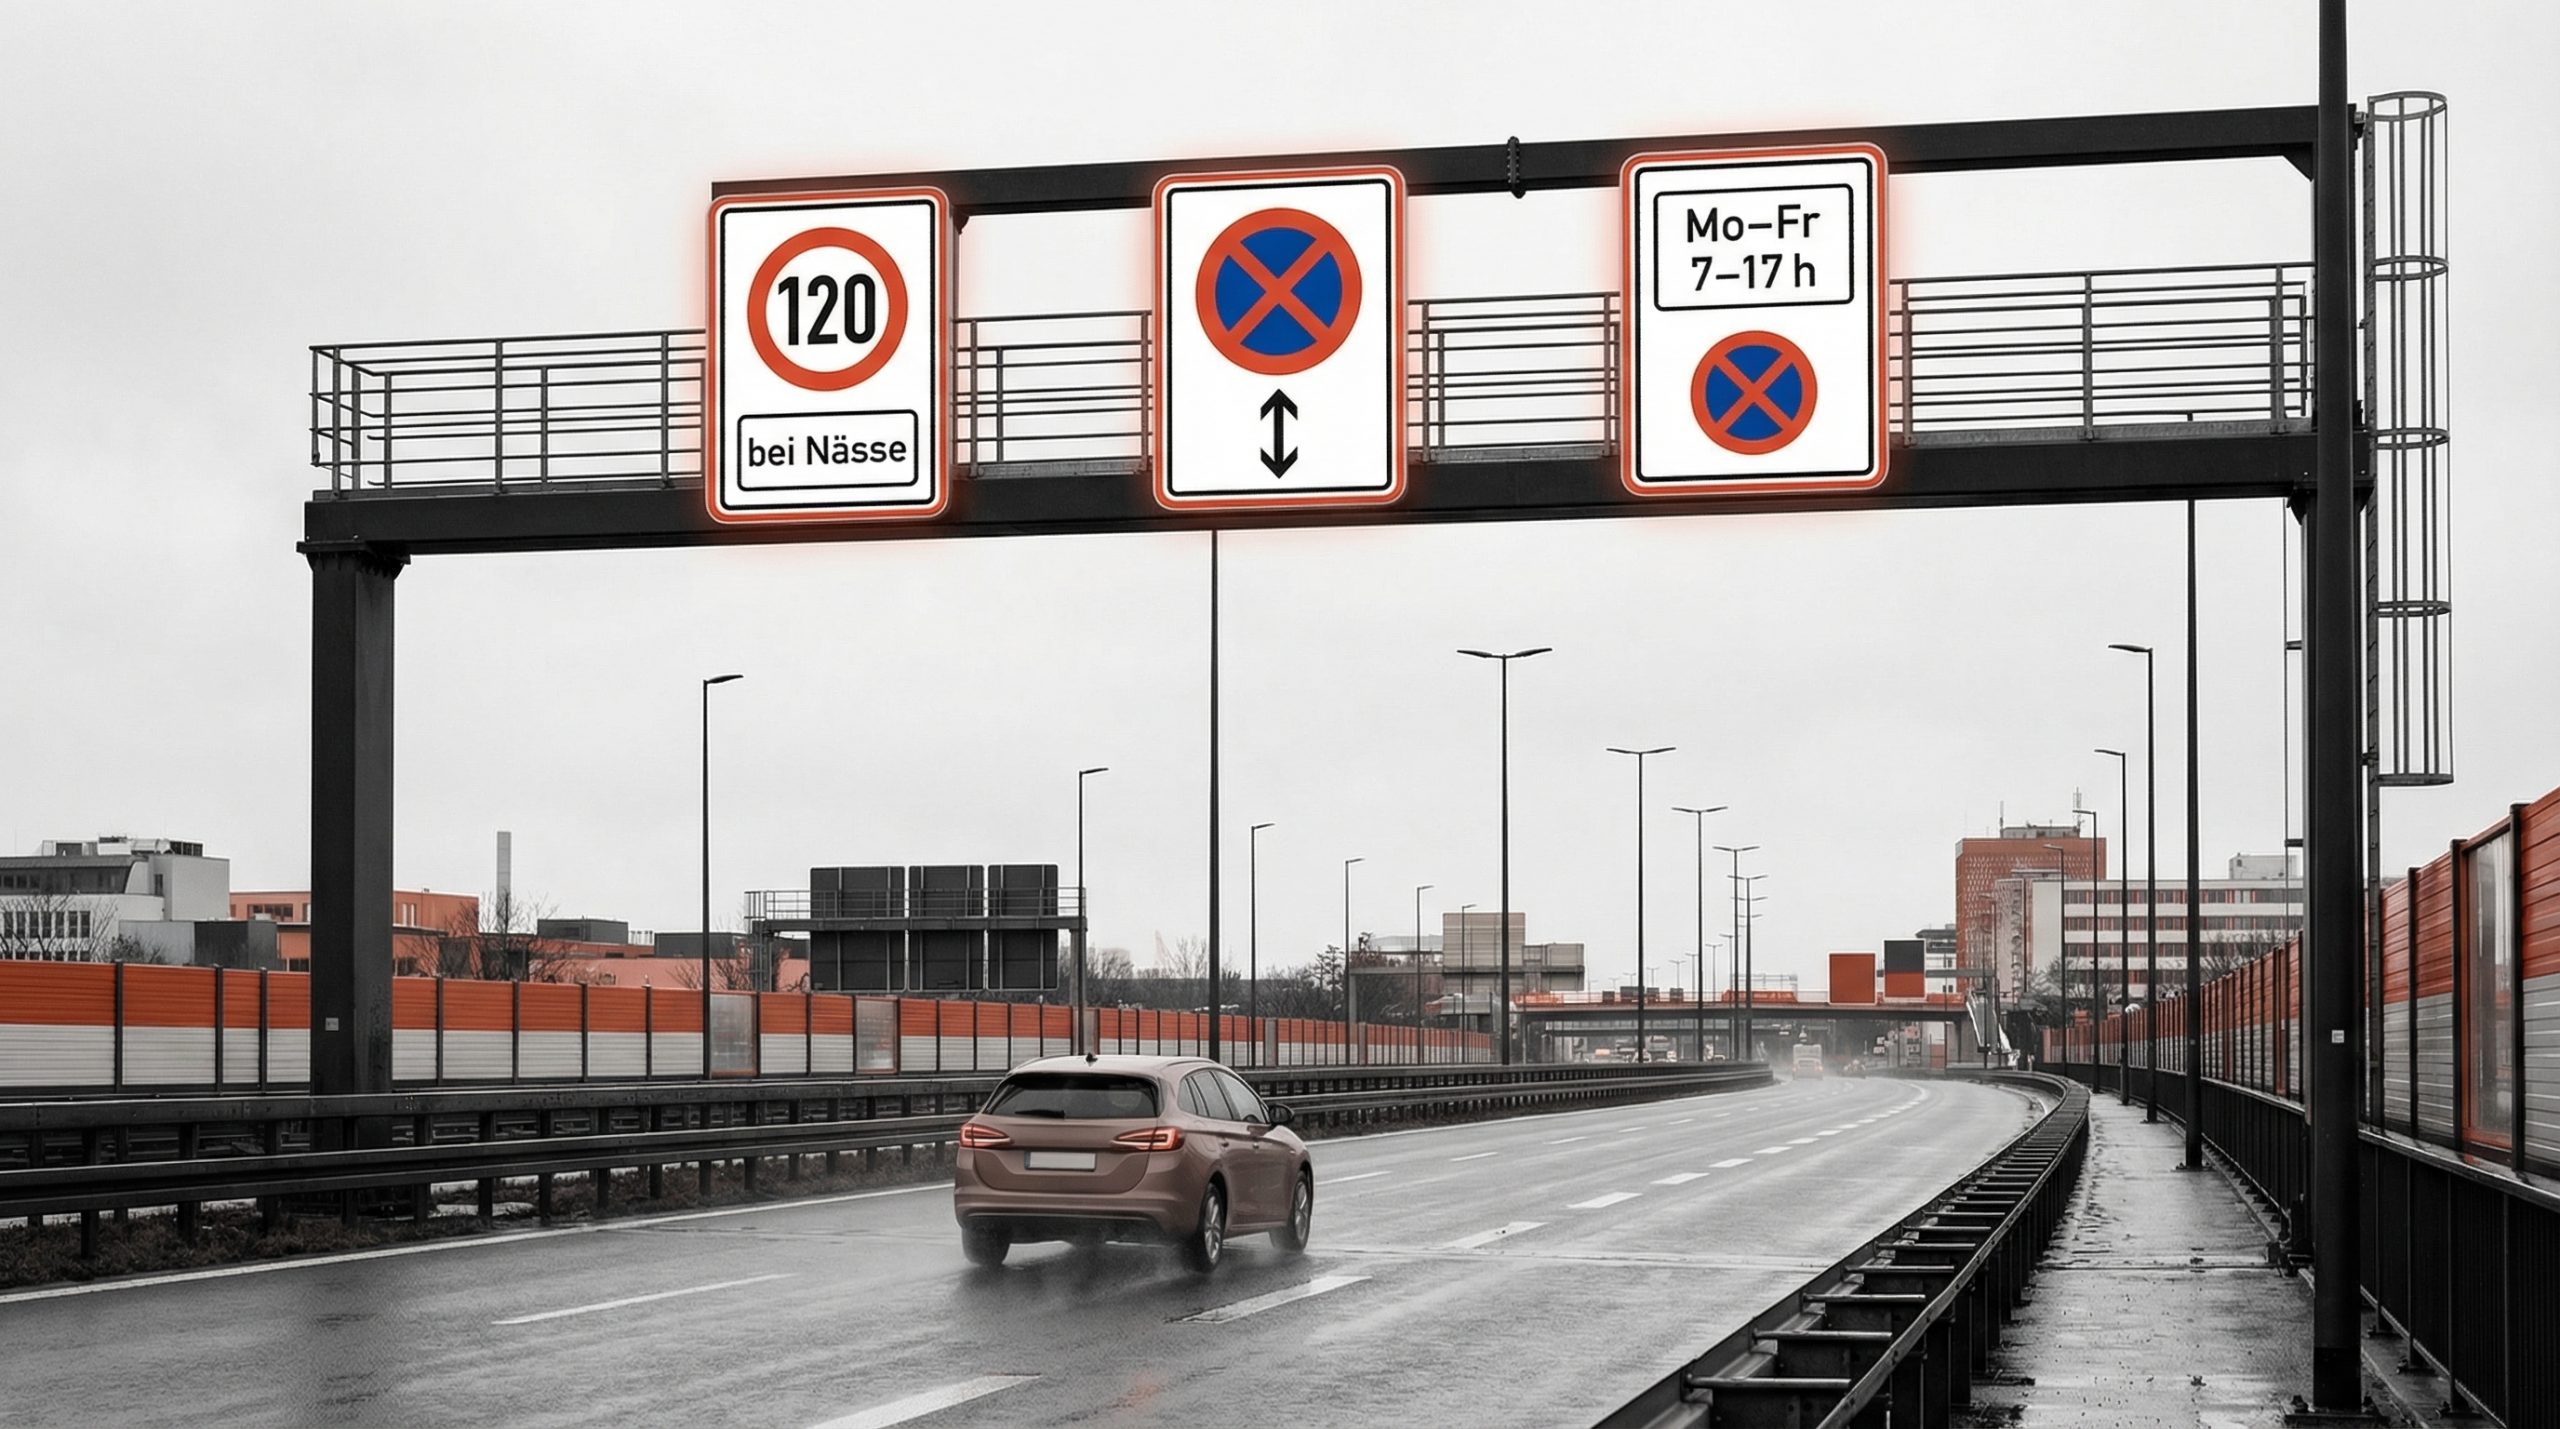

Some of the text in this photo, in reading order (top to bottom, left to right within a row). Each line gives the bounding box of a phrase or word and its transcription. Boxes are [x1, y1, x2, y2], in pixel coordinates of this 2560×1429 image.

[1794, 253, 1816, 288] h
[778, 273, 876, 346] 120
[749, 435, 907, 467] bei Nässe
